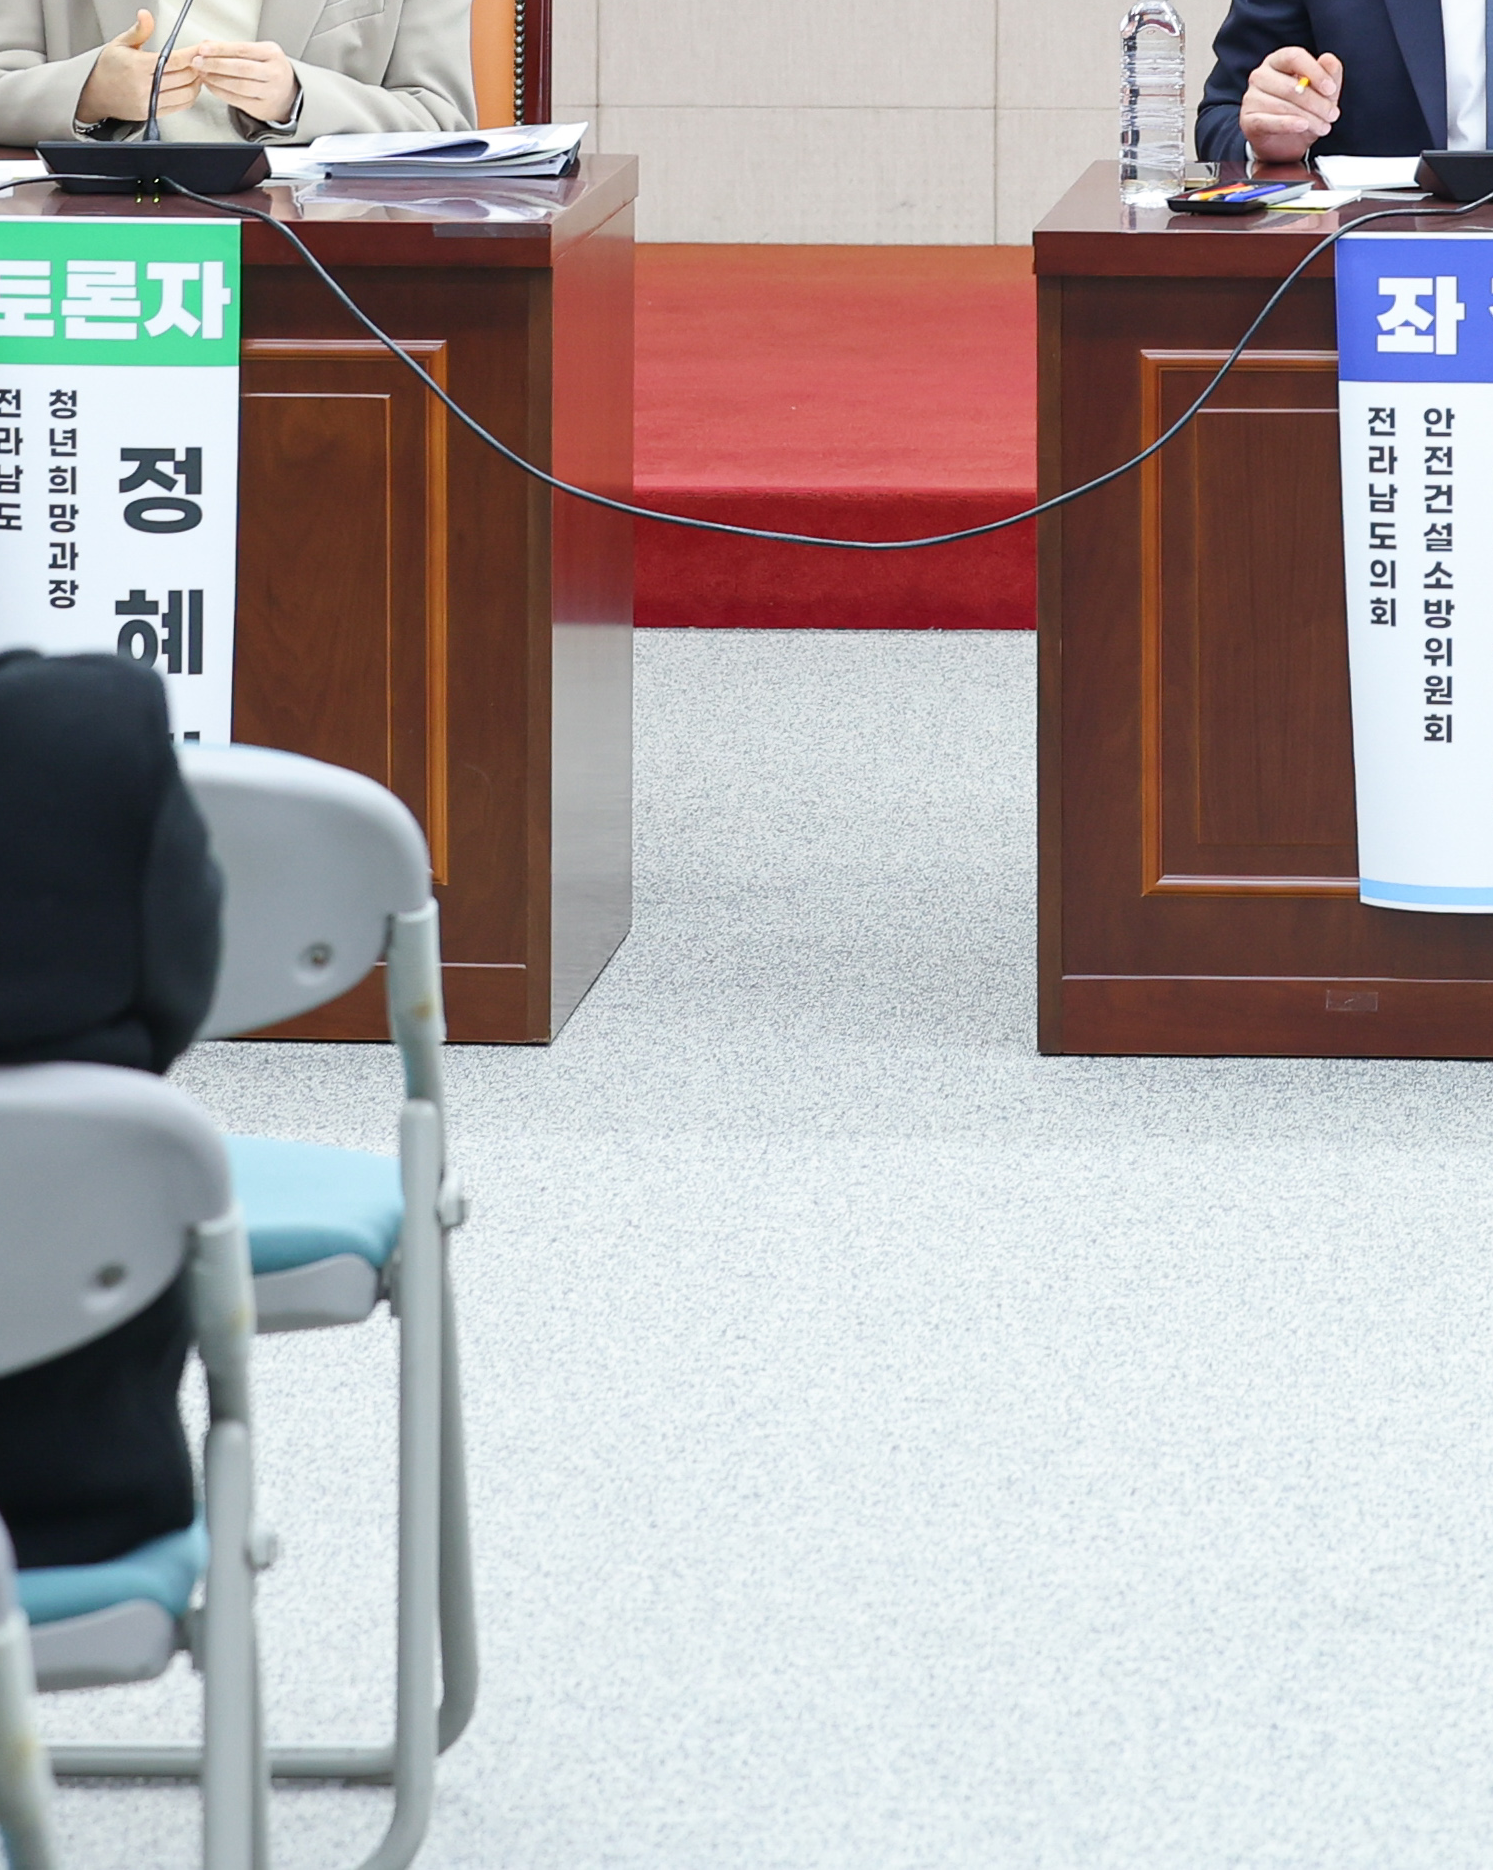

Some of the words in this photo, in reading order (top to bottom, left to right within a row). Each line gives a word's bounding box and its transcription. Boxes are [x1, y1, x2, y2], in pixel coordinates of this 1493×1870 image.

[48, 389, 79, 609] 청년희망과장
[114, 447, 205, 740] 정혜
[1367, 407, 1398, 627] 전라남도의회
[1423, 407, 1455, 744] 안전건설소방위원회
